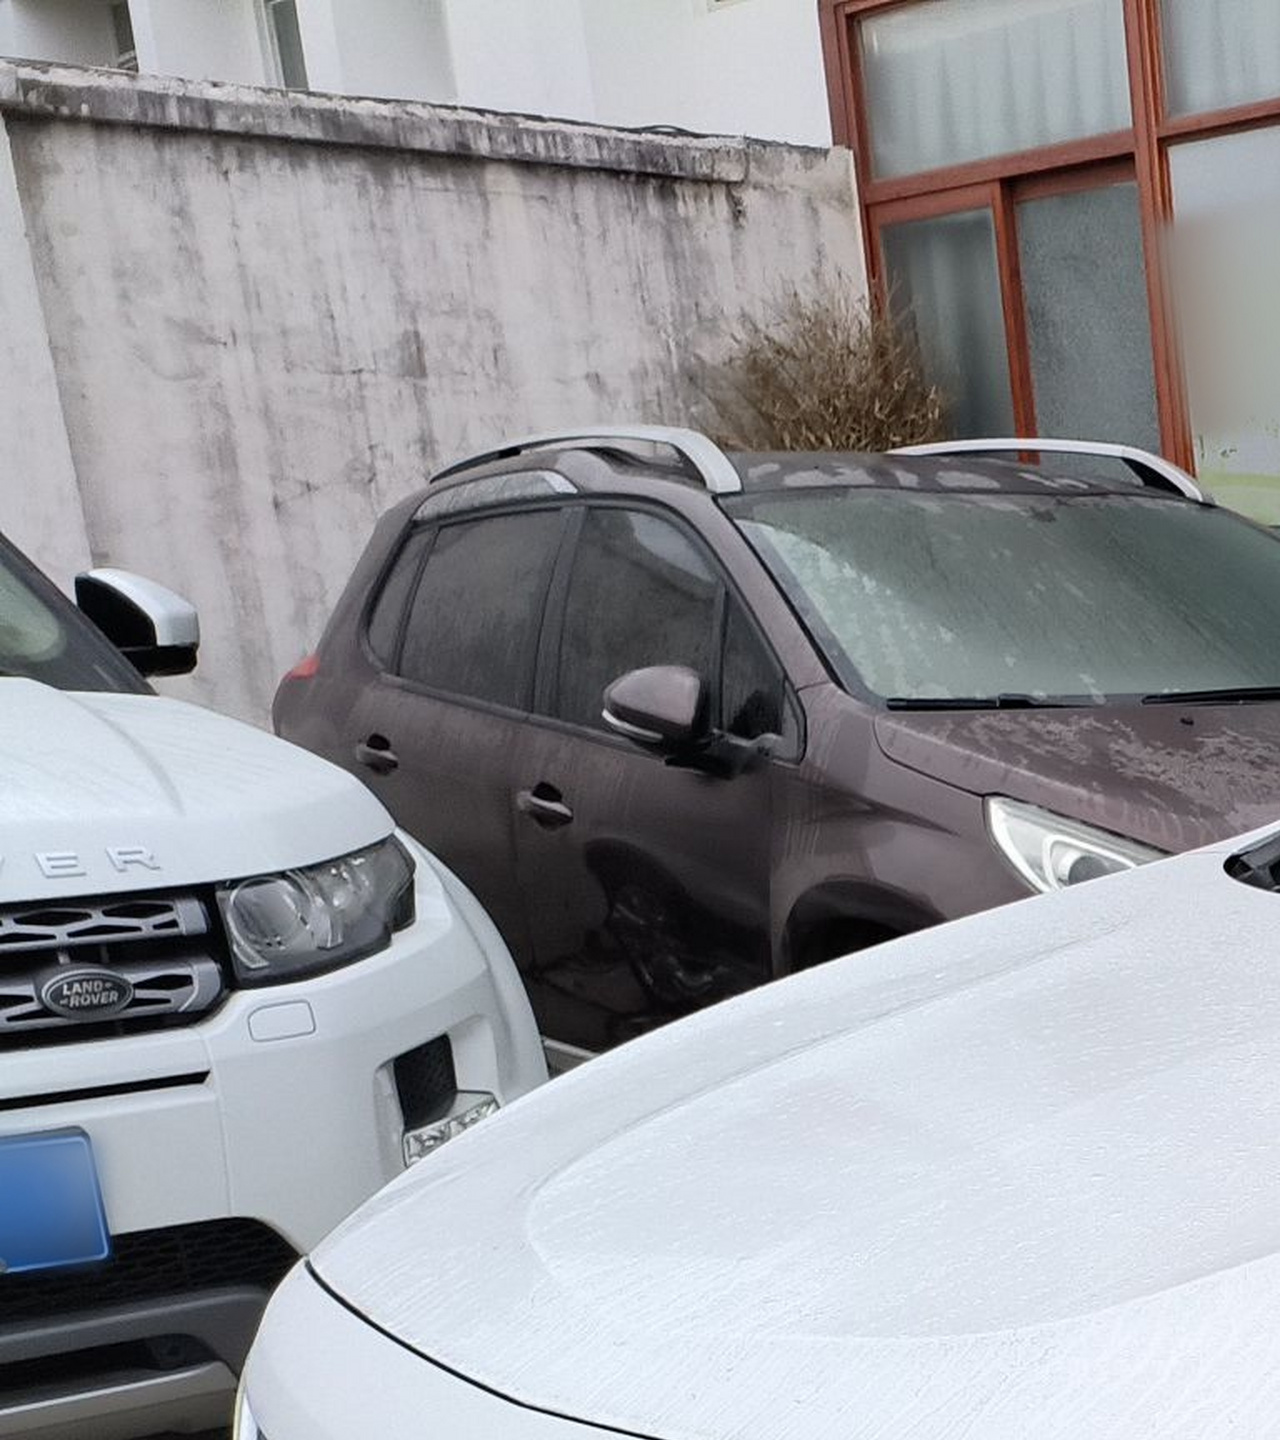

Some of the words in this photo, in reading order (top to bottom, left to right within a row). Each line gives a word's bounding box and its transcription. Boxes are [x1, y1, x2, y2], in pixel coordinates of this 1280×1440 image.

[0, 845, 162, 879] ER
[62, 980, 104, 996] LAND
[69, 990, 119, 1008] ROVER
